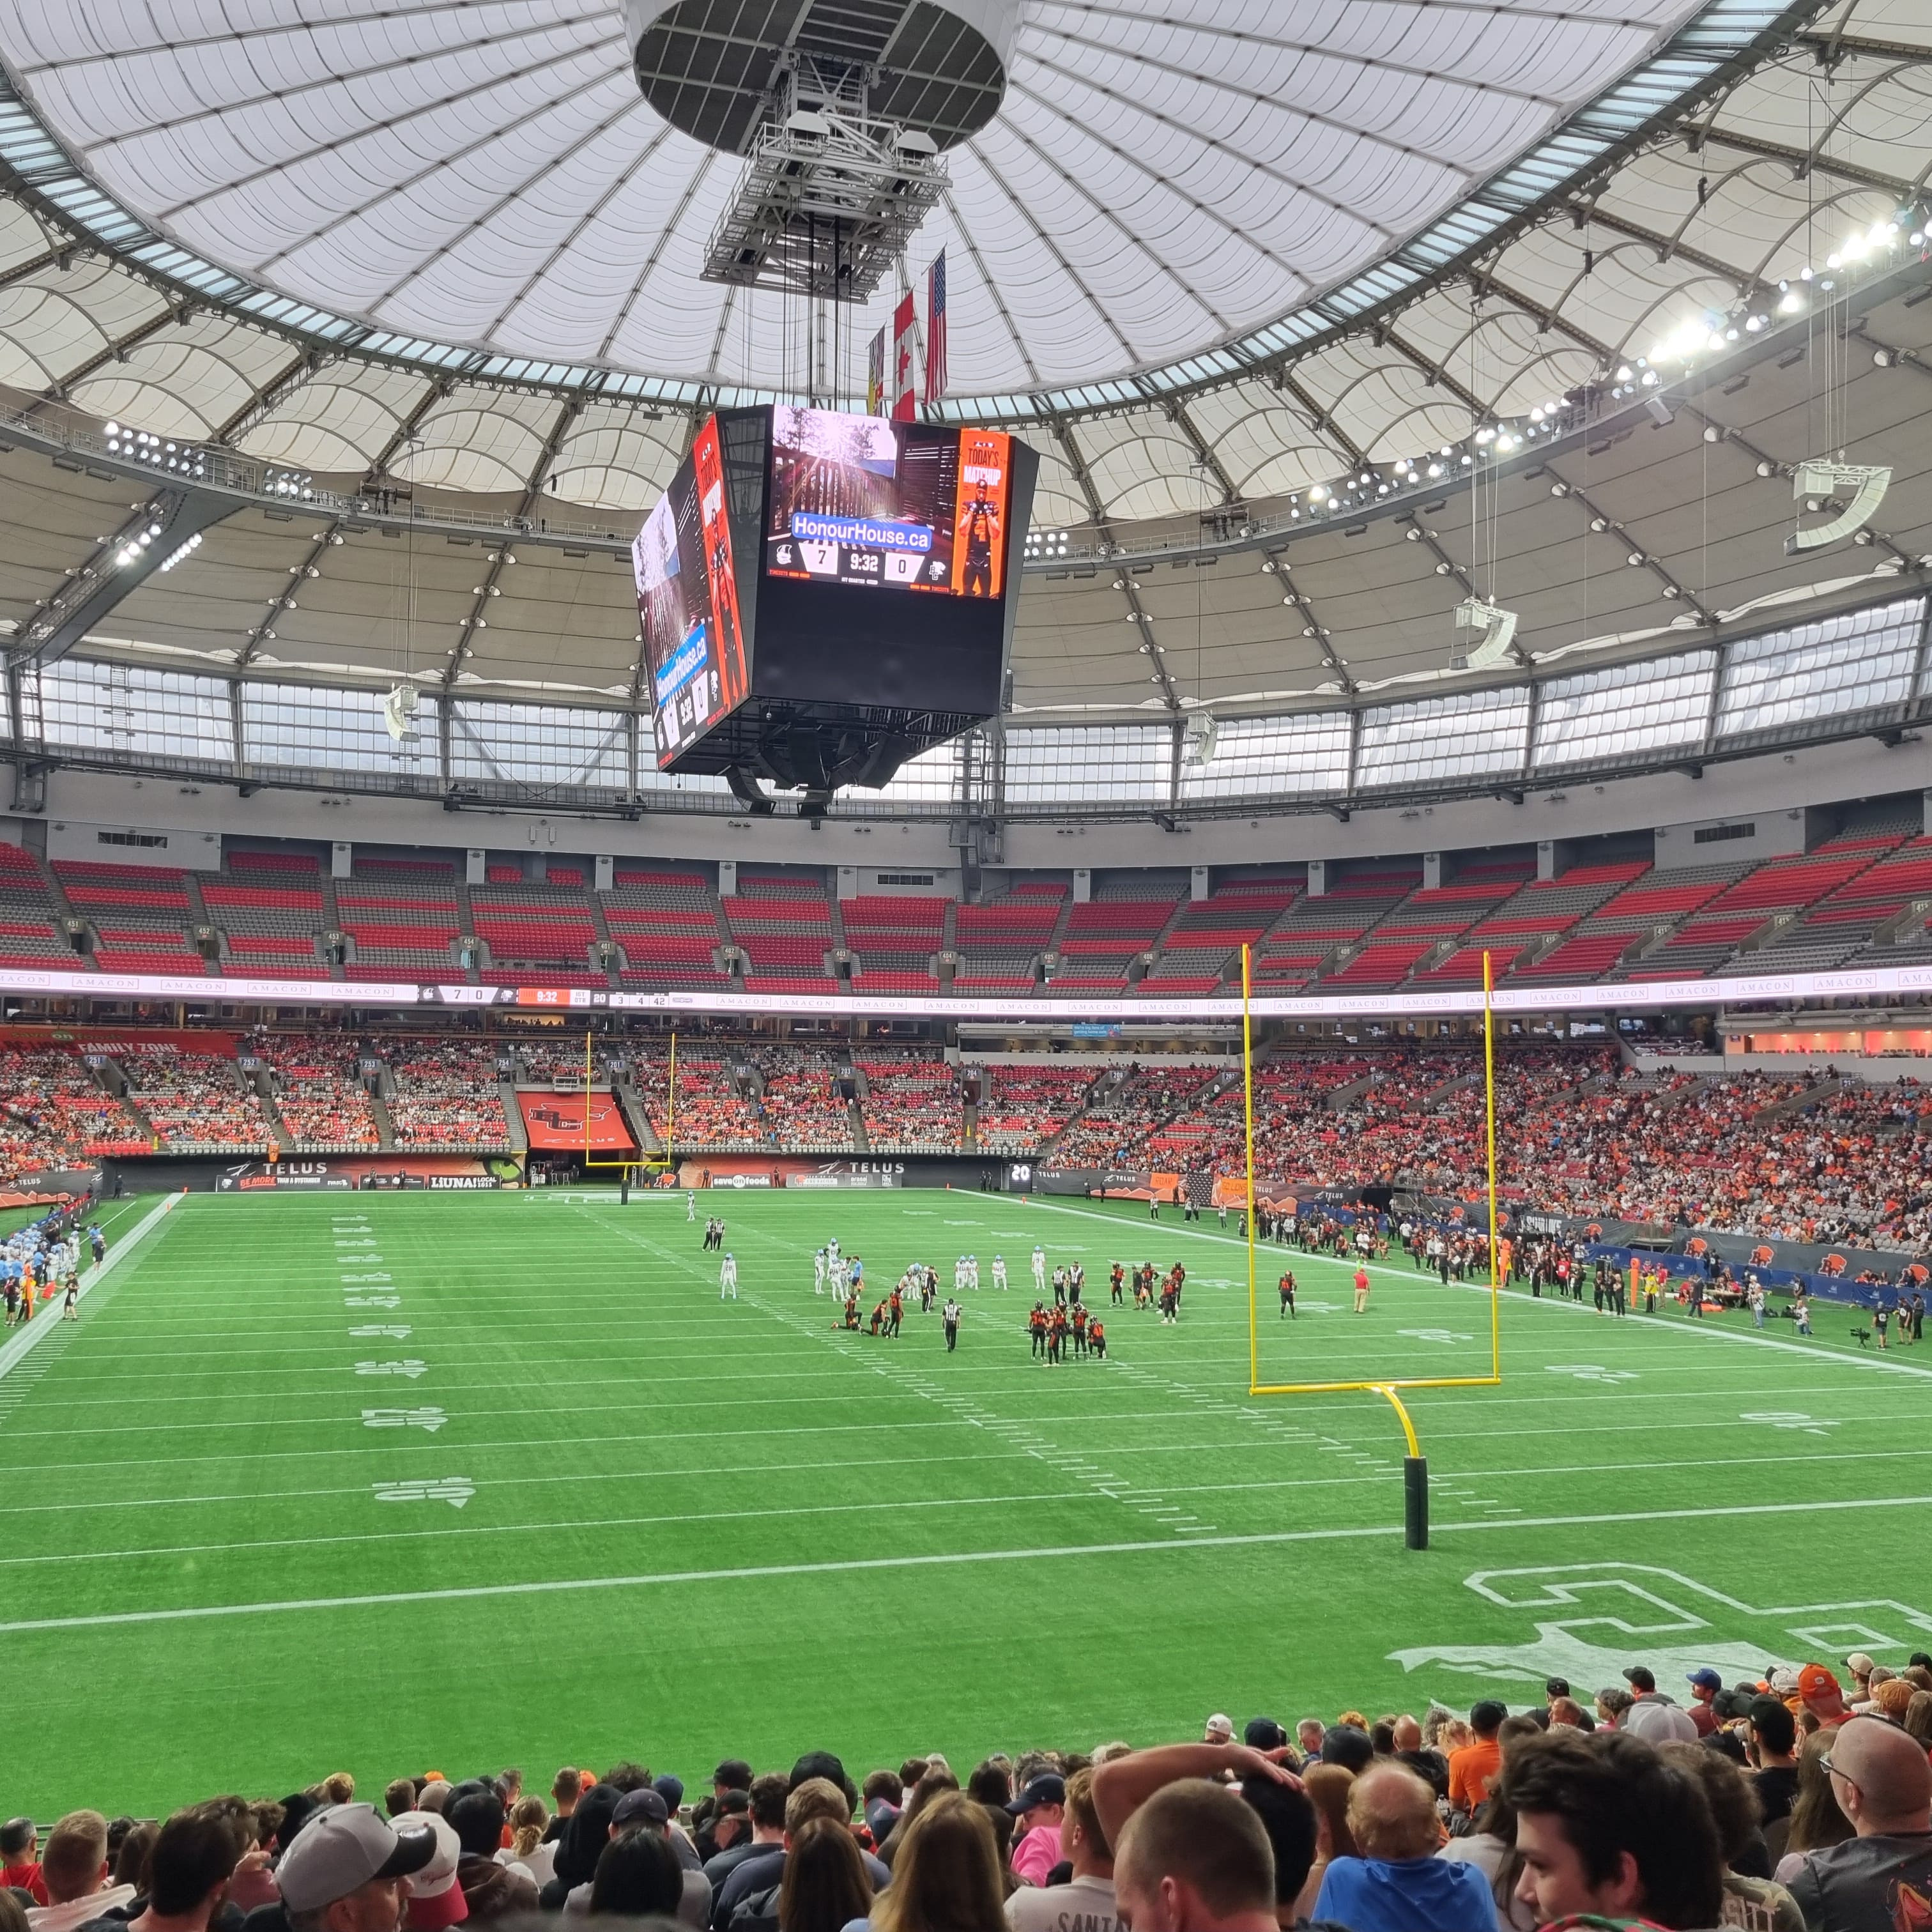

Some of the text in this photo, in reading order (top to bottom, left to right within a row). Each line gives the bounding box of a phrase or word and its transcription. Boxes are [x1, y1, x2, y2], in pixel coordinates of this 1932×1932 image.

[969, 448, 999, 467] TODAY'S
[963, 465, 1001, 486] MATCHUP
[794, 517, 928, 548] HonourHouse.ca
[818, 550, 826, 564] 7
[850, 553, 878, 572] 9:32
[898, 560, 906, 574] 0
[76, 979, 135, 987] AMACON
[165, 981, 222, 990] AMACON
[1740, 982, 1790, 992] AMACON
[1817, 977, 1873, 988] AMACON
[454, 989, 461, 999] 7
[476, 990, 482, 1000] 0
[1600, 990, 1645, 999] AMACON
[1668, 986, 1716, 996] AMACON
[537, 991, 557, 1002] 9:32
[594, 994, 606, 1002] 20
[618, 997, 623, 1005] 3
[638, 997, 643, 1005] 4
[654, 997, 664, 1005] 42
[1406, 997, 1448, 1006] AMACON
[1533, 993, 1577, 1002] AMACON
[1342, 999, 1385, 1008] AMACON
[78, 1043, 182, 1053] FAMILY ZONE
[263, 1162, 327, 1174] TELUS
[850, 1162, 905, 1173] TELUS
[1011, 1165, 1030, 1181] 20
[19, 1177, 41, 1186] TELUS
[240, 1178, 251, 1186] BE
[251, 1176, 277, 1184] MORE
[746, 1176, 769, 1185] foods
